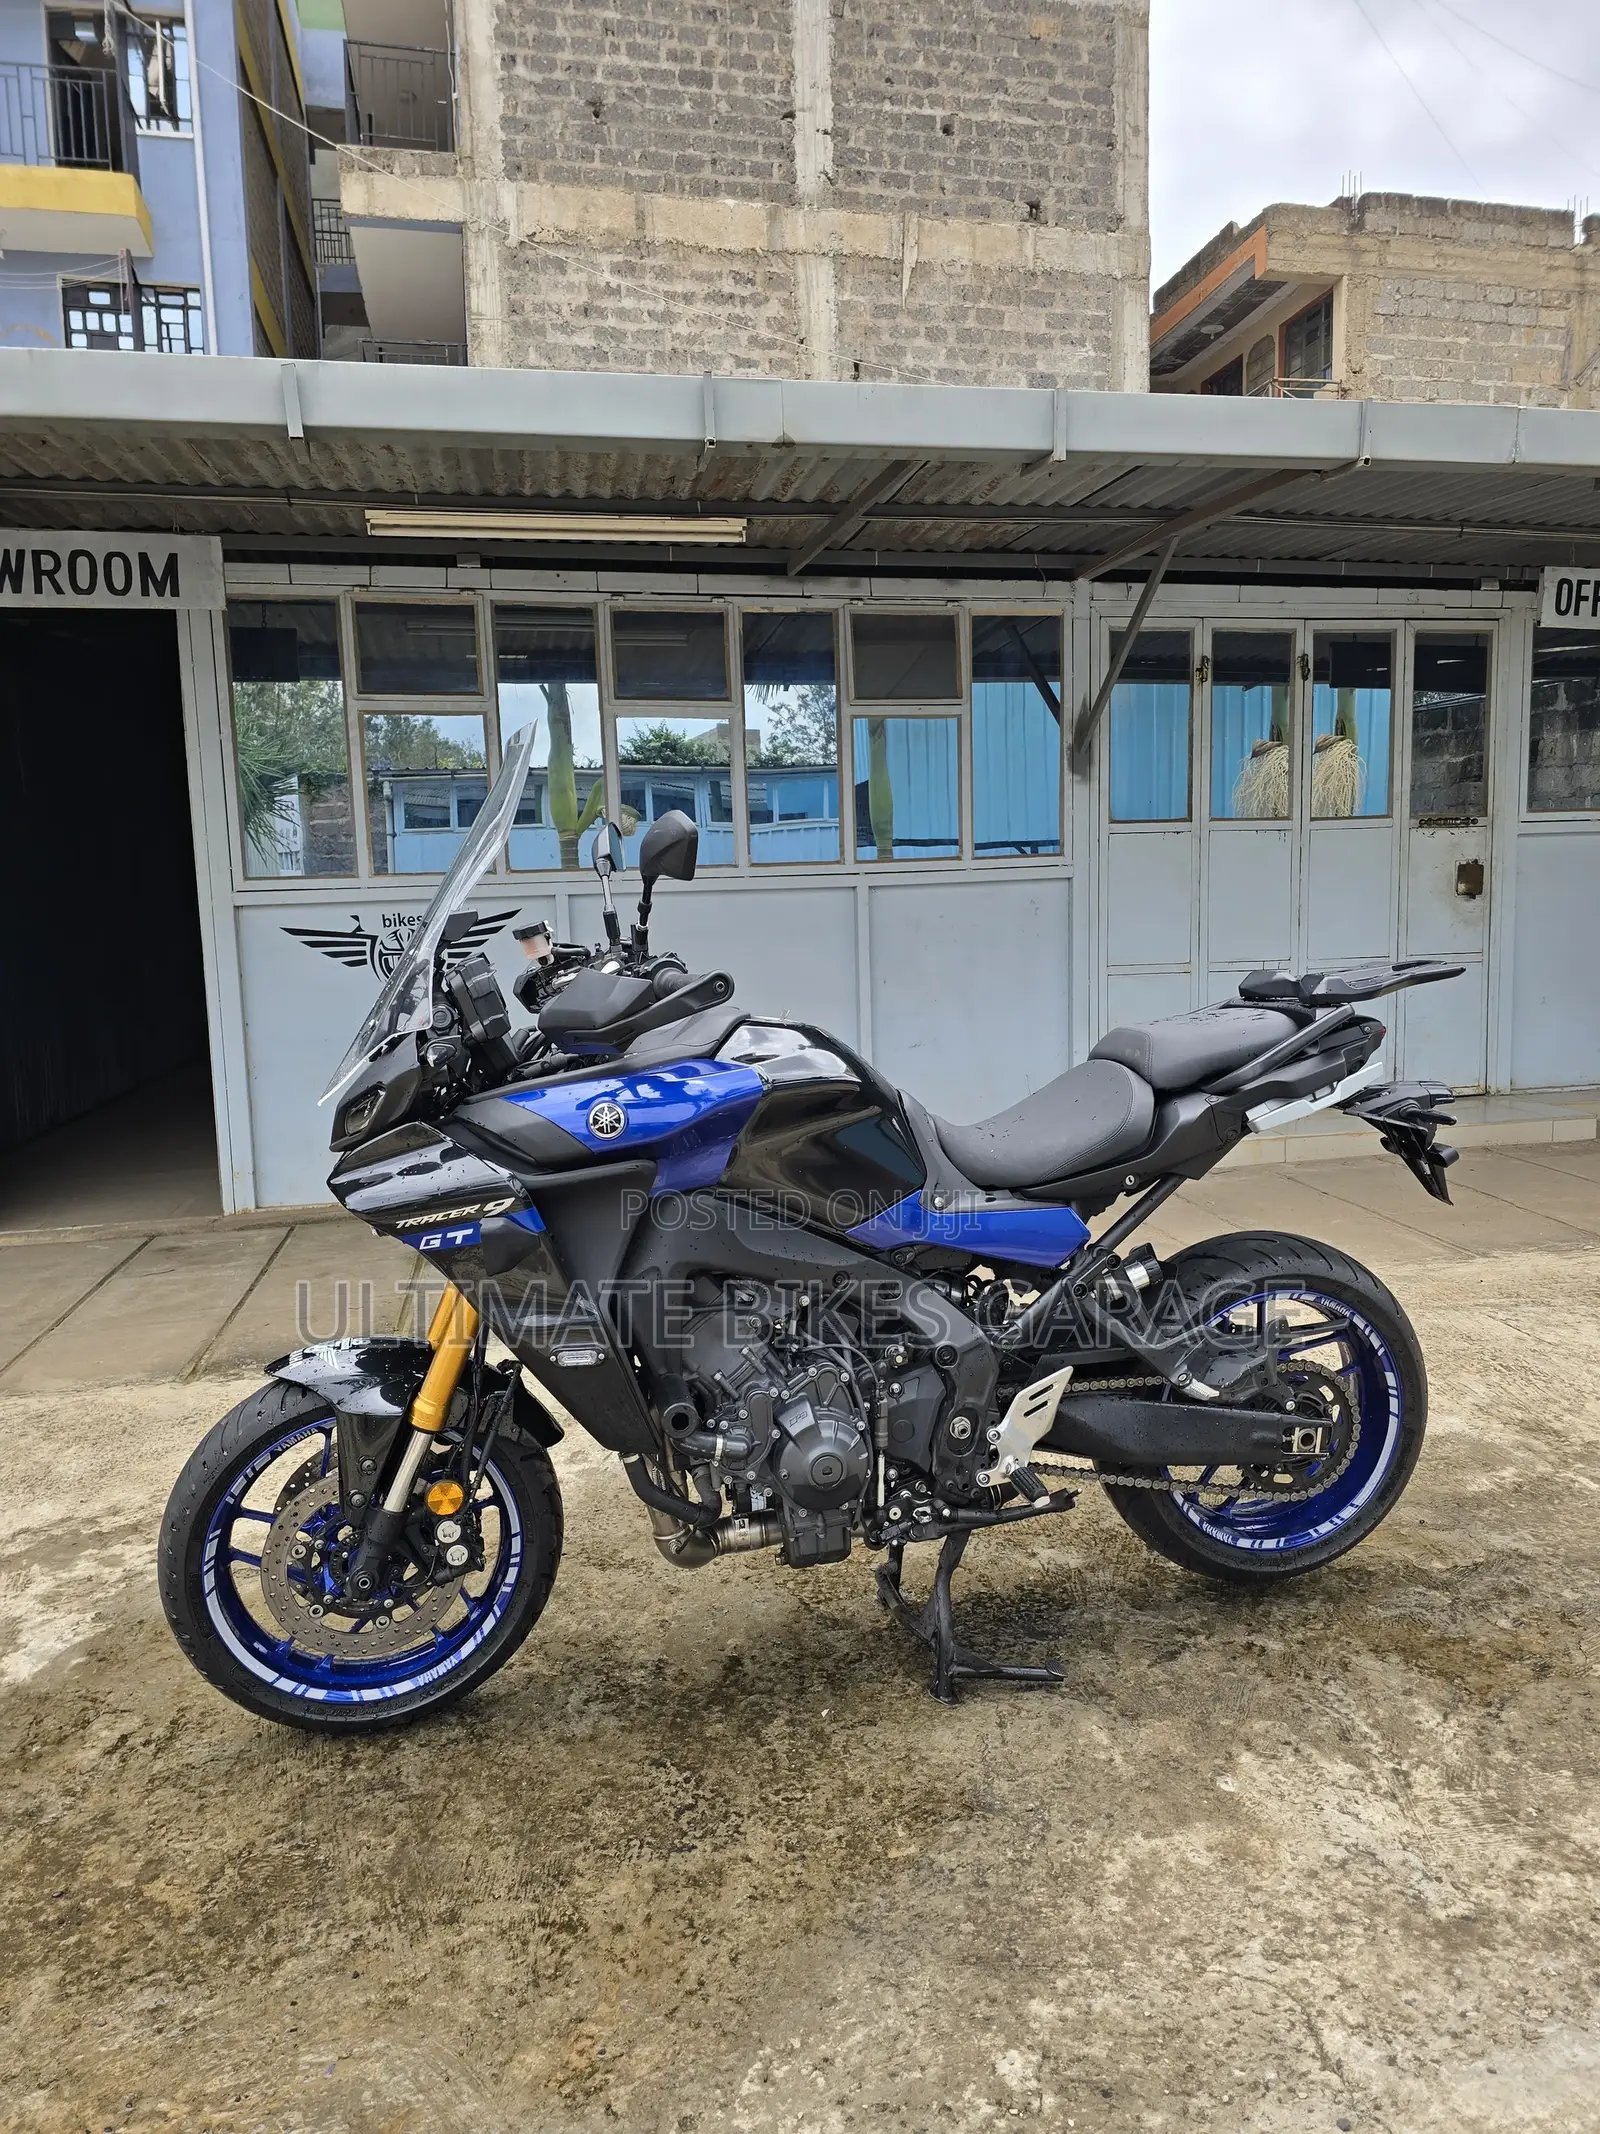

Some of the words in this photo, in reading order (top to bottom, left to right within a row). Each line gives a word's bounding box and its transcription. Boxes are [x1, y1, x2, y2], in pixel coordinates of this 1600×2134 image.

[0, 549, 180, 597] WROOM
[419, 1228, 474, 1250] GT
[273, 1427, 319, 1452] YAMAHA
[417, 1655, 459, 1687] YAMAHA
